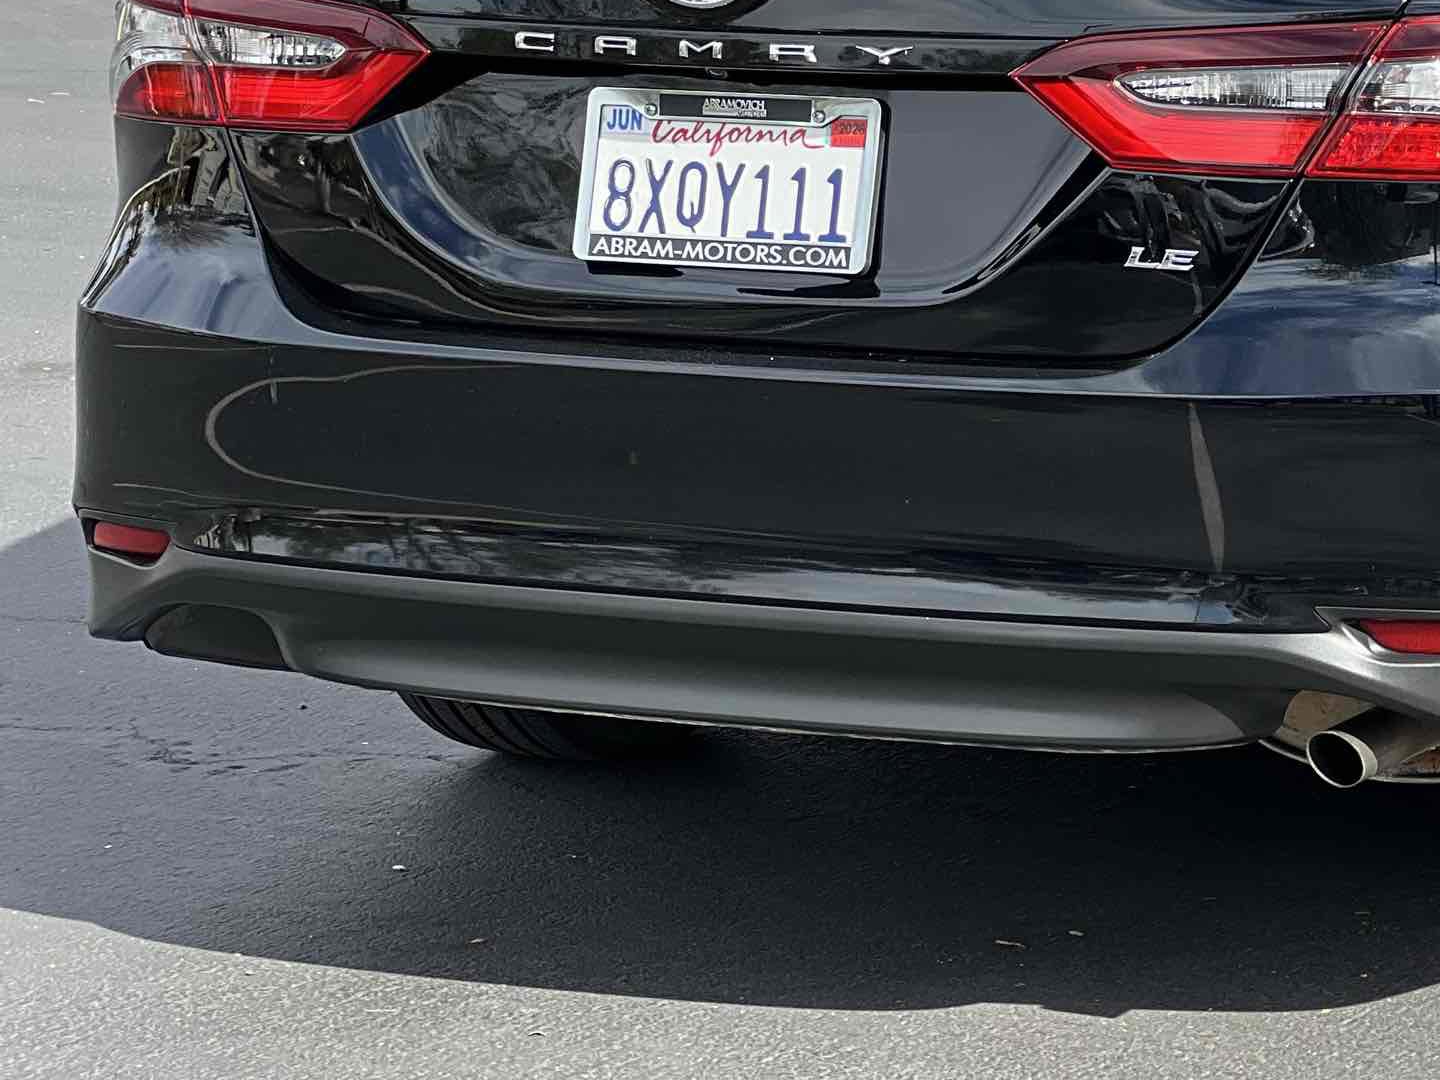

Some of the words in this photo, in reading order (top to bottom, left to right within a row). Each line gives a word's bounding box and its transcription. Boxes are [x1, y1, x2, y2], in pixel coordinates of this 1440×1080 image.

[514, 30, 914, 64] CAMRY
[607, 107, 643, 131] JUN
[651, 120, 826, 156] California
[602, 158, 848, 244] 8XQY111
[592, 237, 848, 267] ABRAM-MOTORS.COM
[1124, 246, 1199, 270] LE
